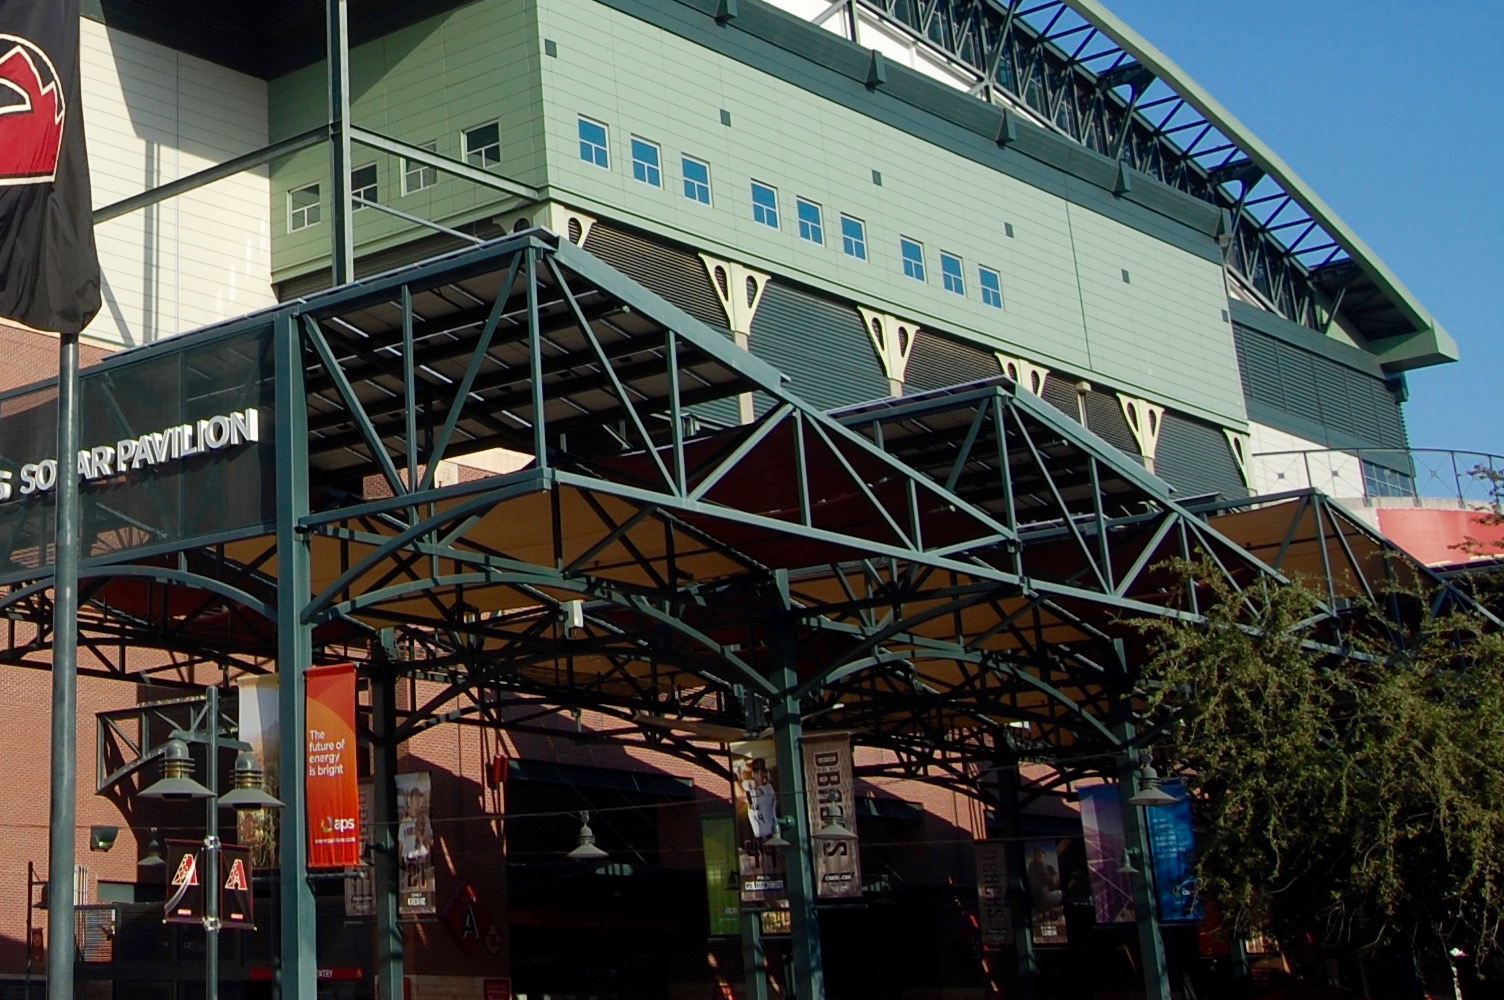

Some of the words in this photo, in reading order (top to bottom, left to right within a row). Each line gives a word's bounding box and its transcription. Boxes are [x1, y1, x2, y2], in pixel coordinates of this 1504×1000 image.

[20, 446, 115, 495] SOAR
[117, 408, 258, 472] PAVILION
[310, 730, 325, 740] The
[309, 741, 334, 752] future
[336, 738, 345, 750] of
[309, 753, 340, 764] energy
[310, 766, 316, 776] is
[318, 764, 343, 776] bright
[334, 818, 354, 832] aps
